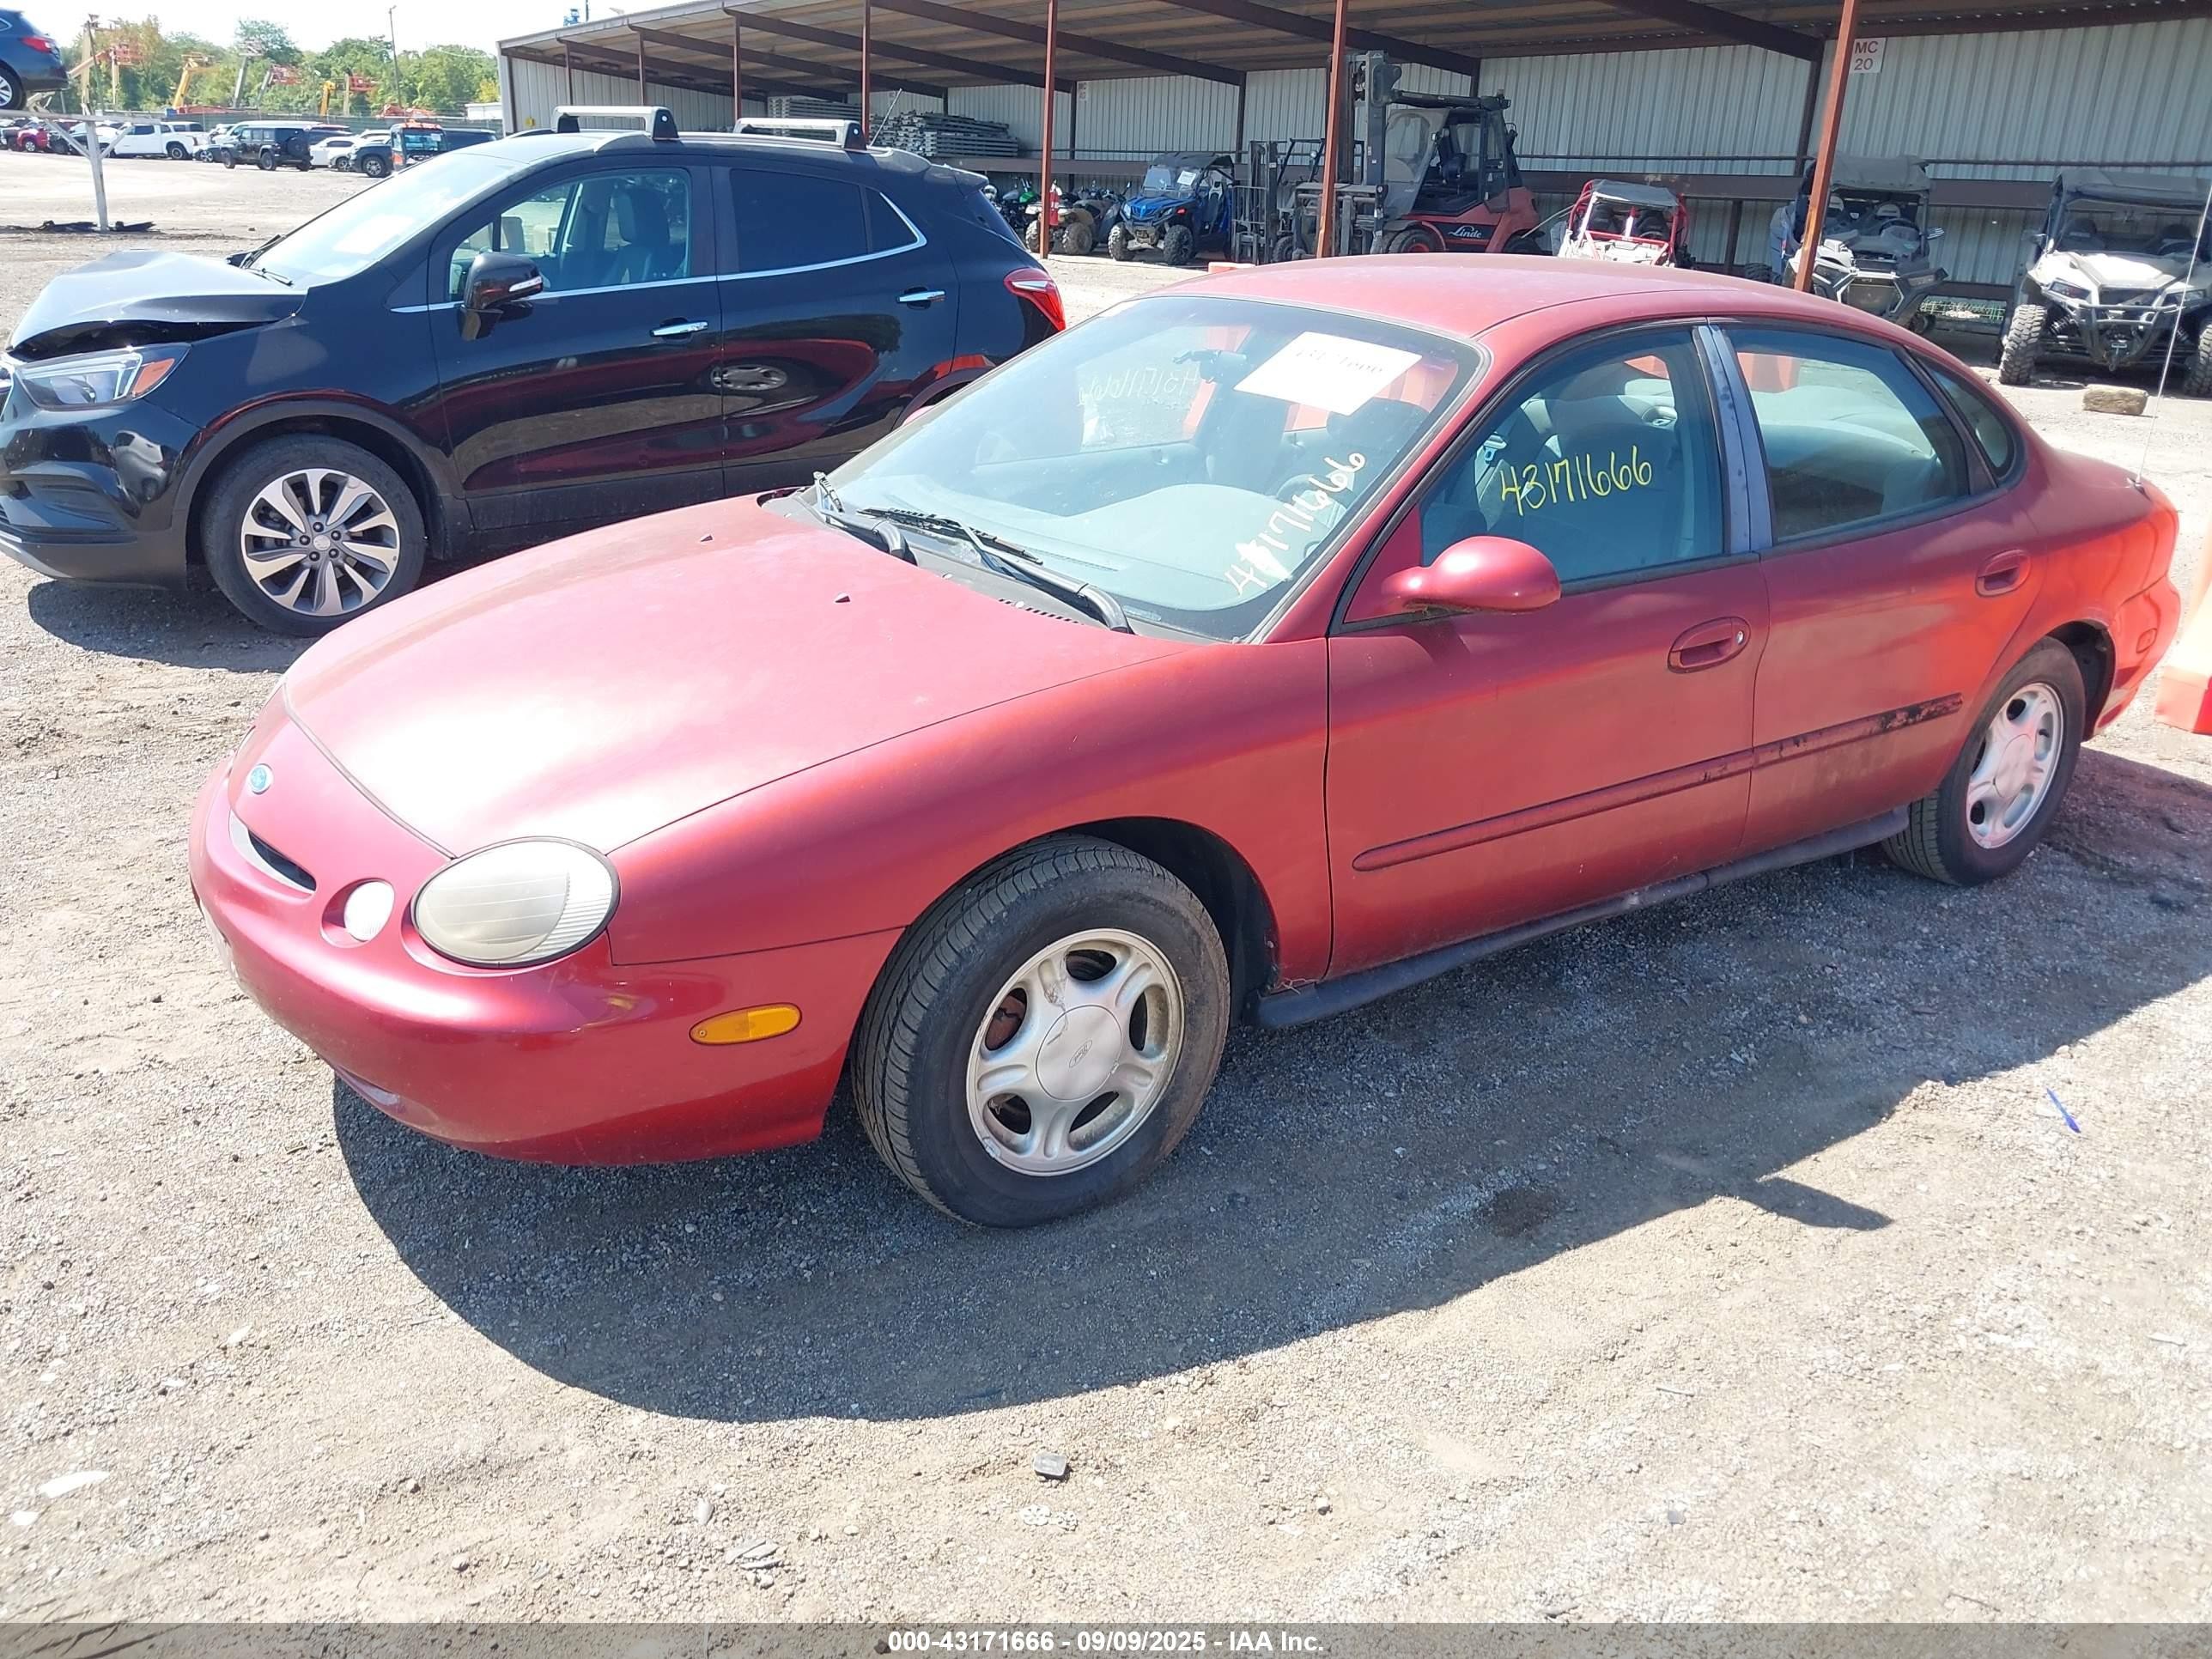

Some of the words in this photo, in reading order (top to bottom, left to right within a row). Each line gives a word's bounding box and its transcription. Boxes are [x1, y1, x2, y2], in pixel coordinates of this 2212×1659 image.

[1855, 40, 1879, 54] MC
[1854, 58, 1874, 70] 20
[1448, 225, 1482, 238] Linde
[1500, 445, 1652, 516] 43171666
